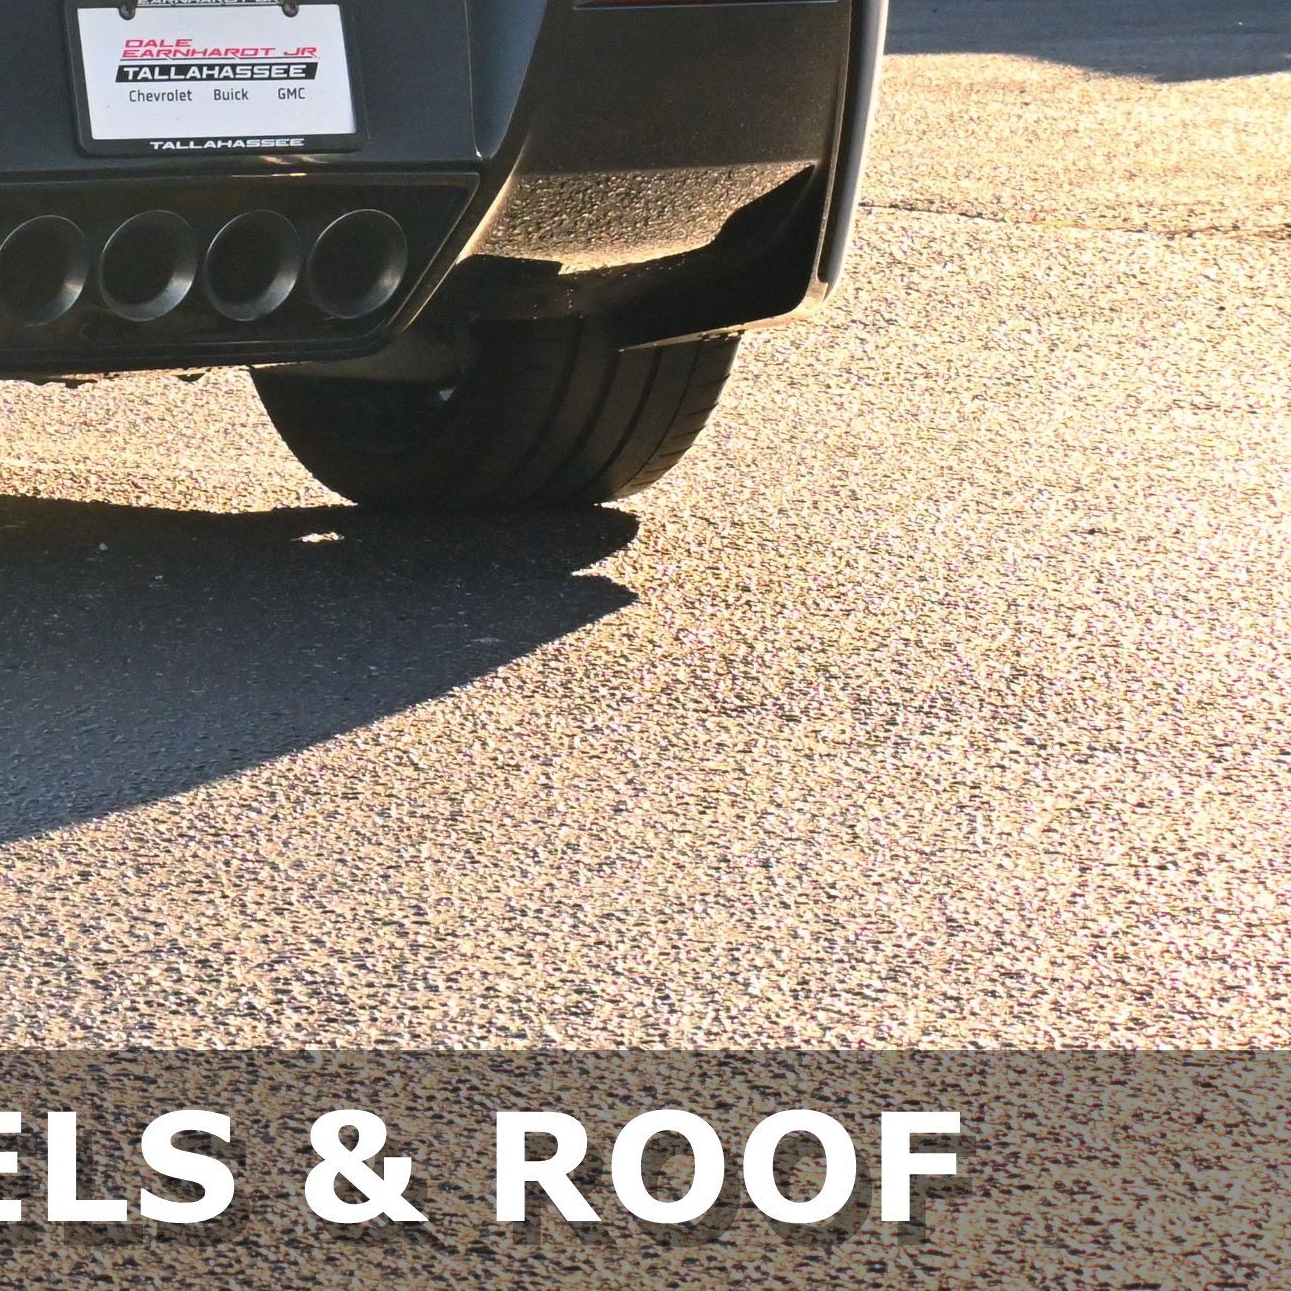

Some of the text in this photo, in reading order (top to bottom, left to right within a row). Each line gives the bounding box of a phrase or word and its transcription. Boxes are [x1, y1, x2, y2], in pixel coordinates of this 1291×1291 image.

[124, 38, 193, 48] DALE
[122, 46, 318, 60] EARNHARDT JR
[123, 64, 307, 81] TALLAHASSEE
[129, 87, 306, 103] Chevrolet Buick GMC
[149, 138, 305, 150] TALLAHASSEE
